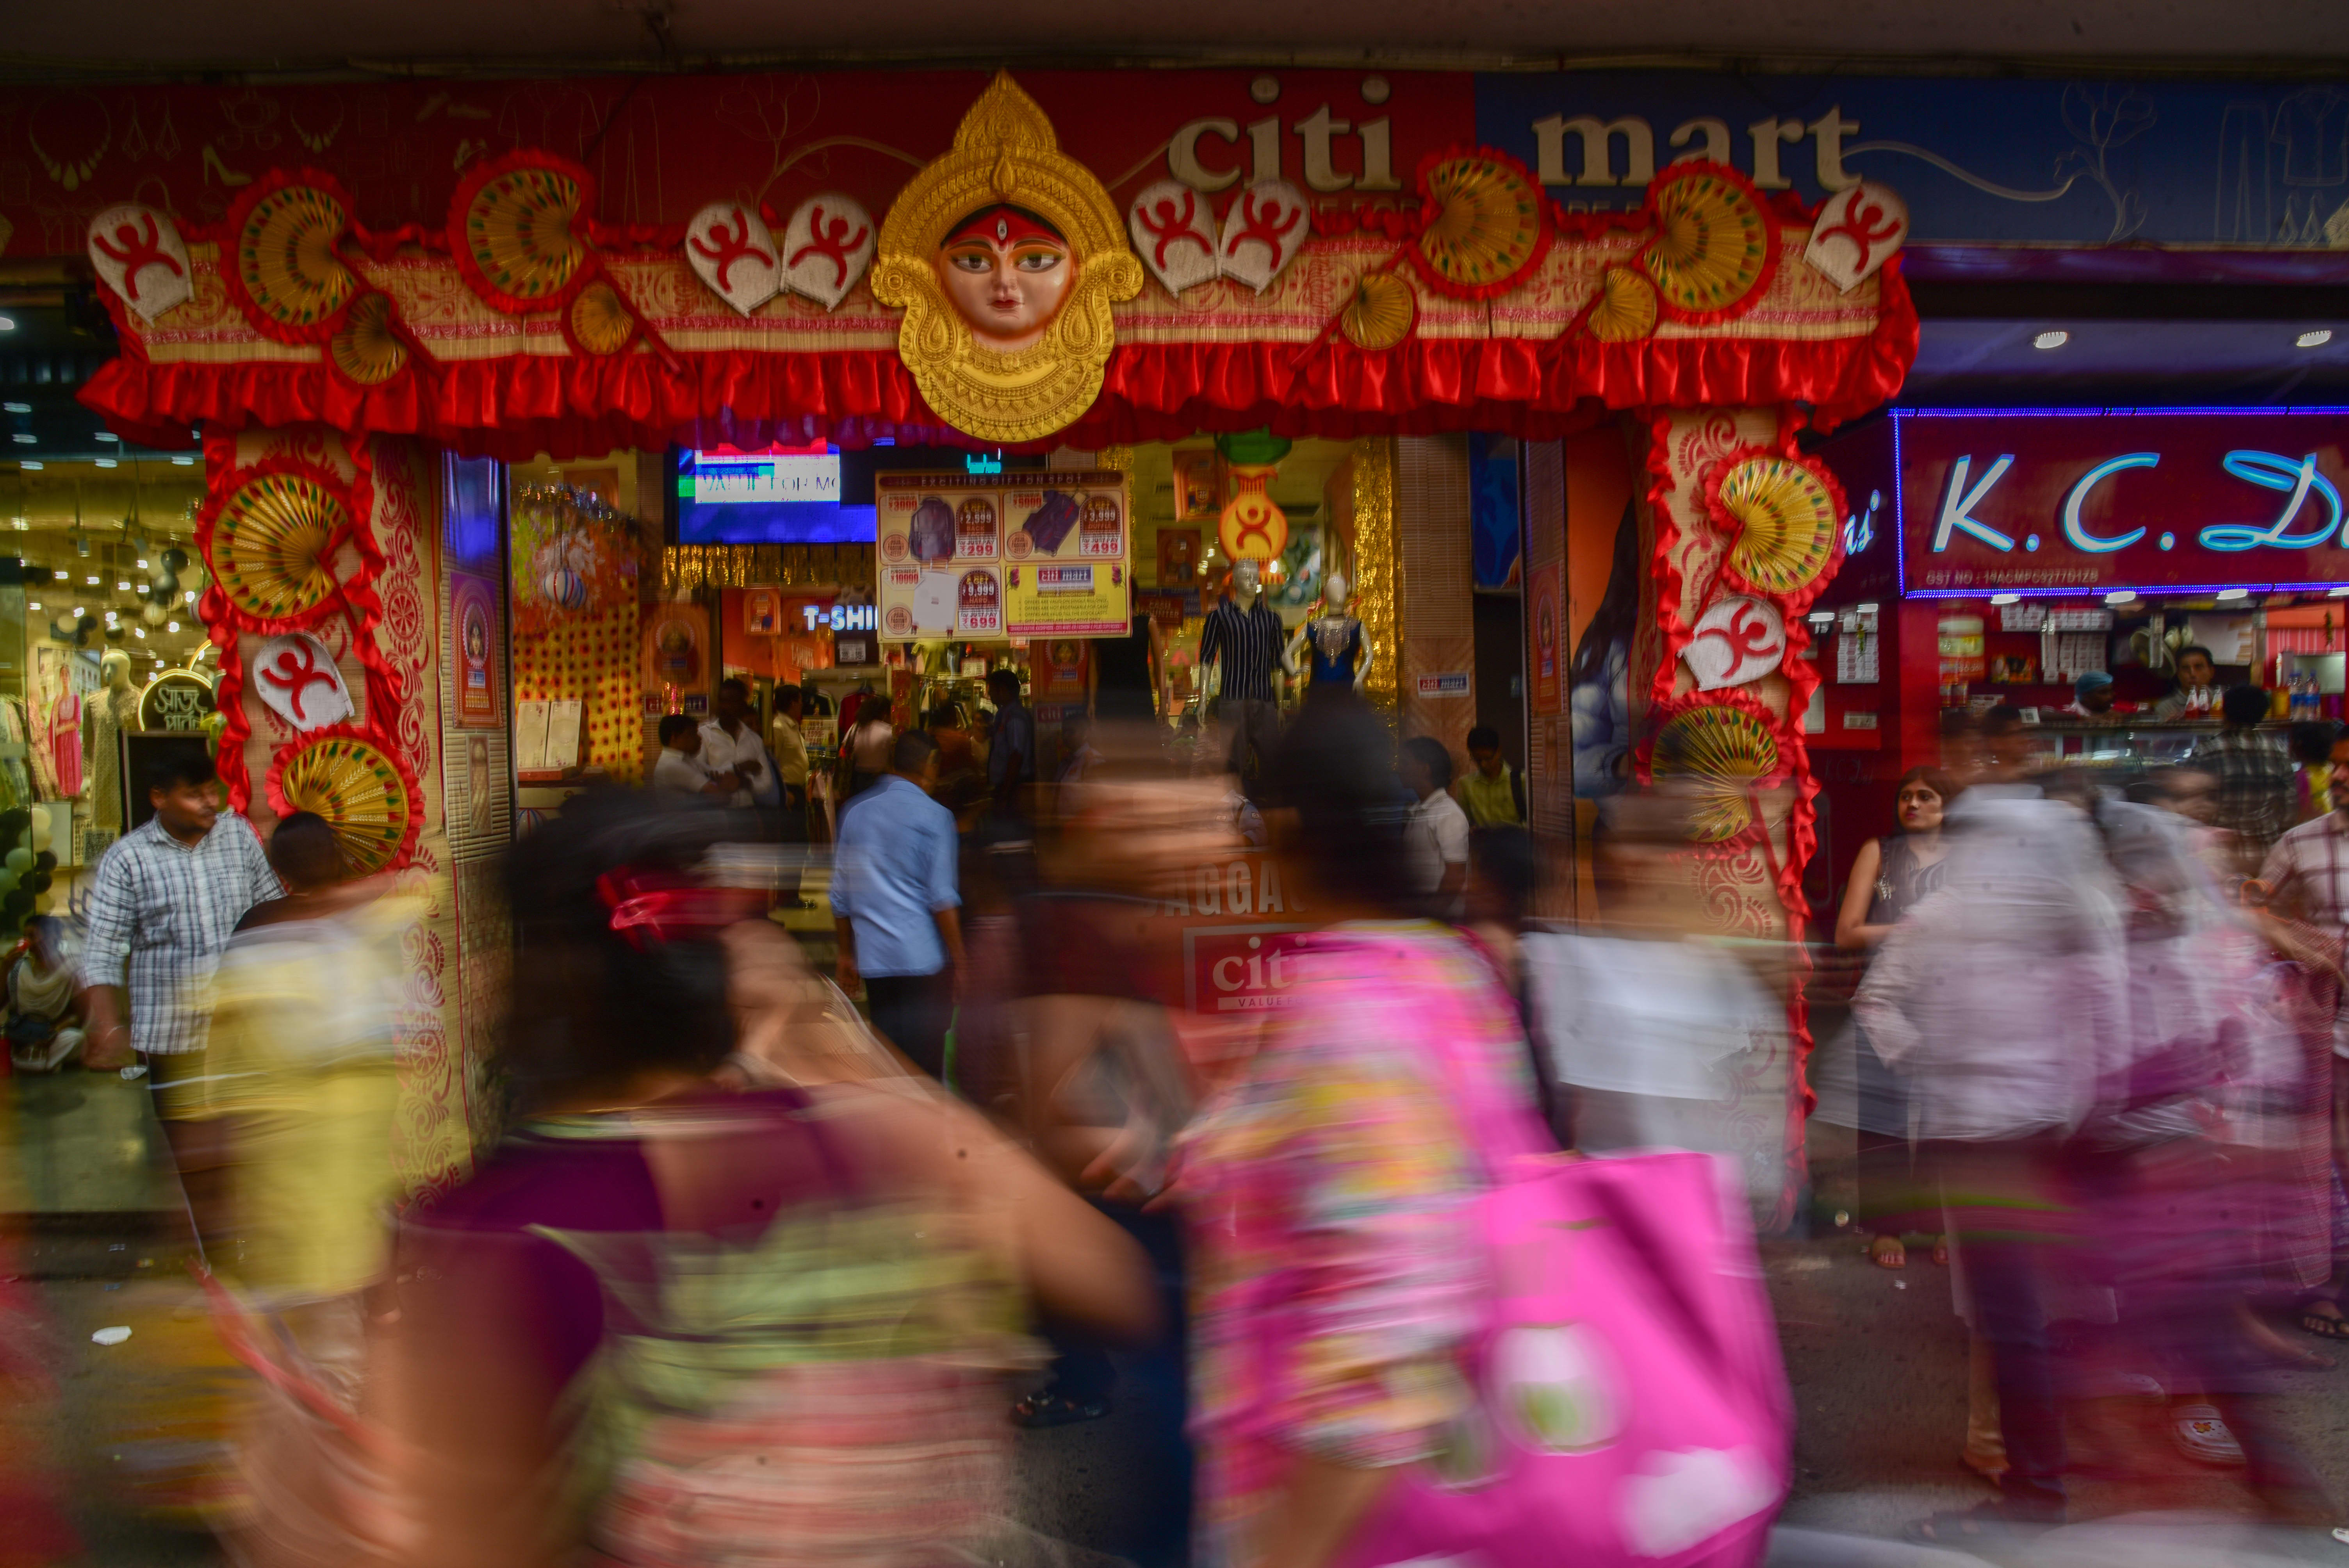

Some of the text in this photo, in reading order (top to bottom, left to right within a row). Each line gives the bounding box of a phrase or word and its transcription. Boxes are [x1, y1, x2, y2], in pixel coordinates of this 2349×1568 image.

[1169, 76, 1861, 192] citi mart
[921, 476, 1081, 487] EXCITING GIFT ON SPOT
[1041, 568, 1088, 581] citi mart
[803, 605, 878, 631] T-SHI
[1422, 677, 1463, 691] citi mart
[1238, 996, 1282, 1007] VALUE
